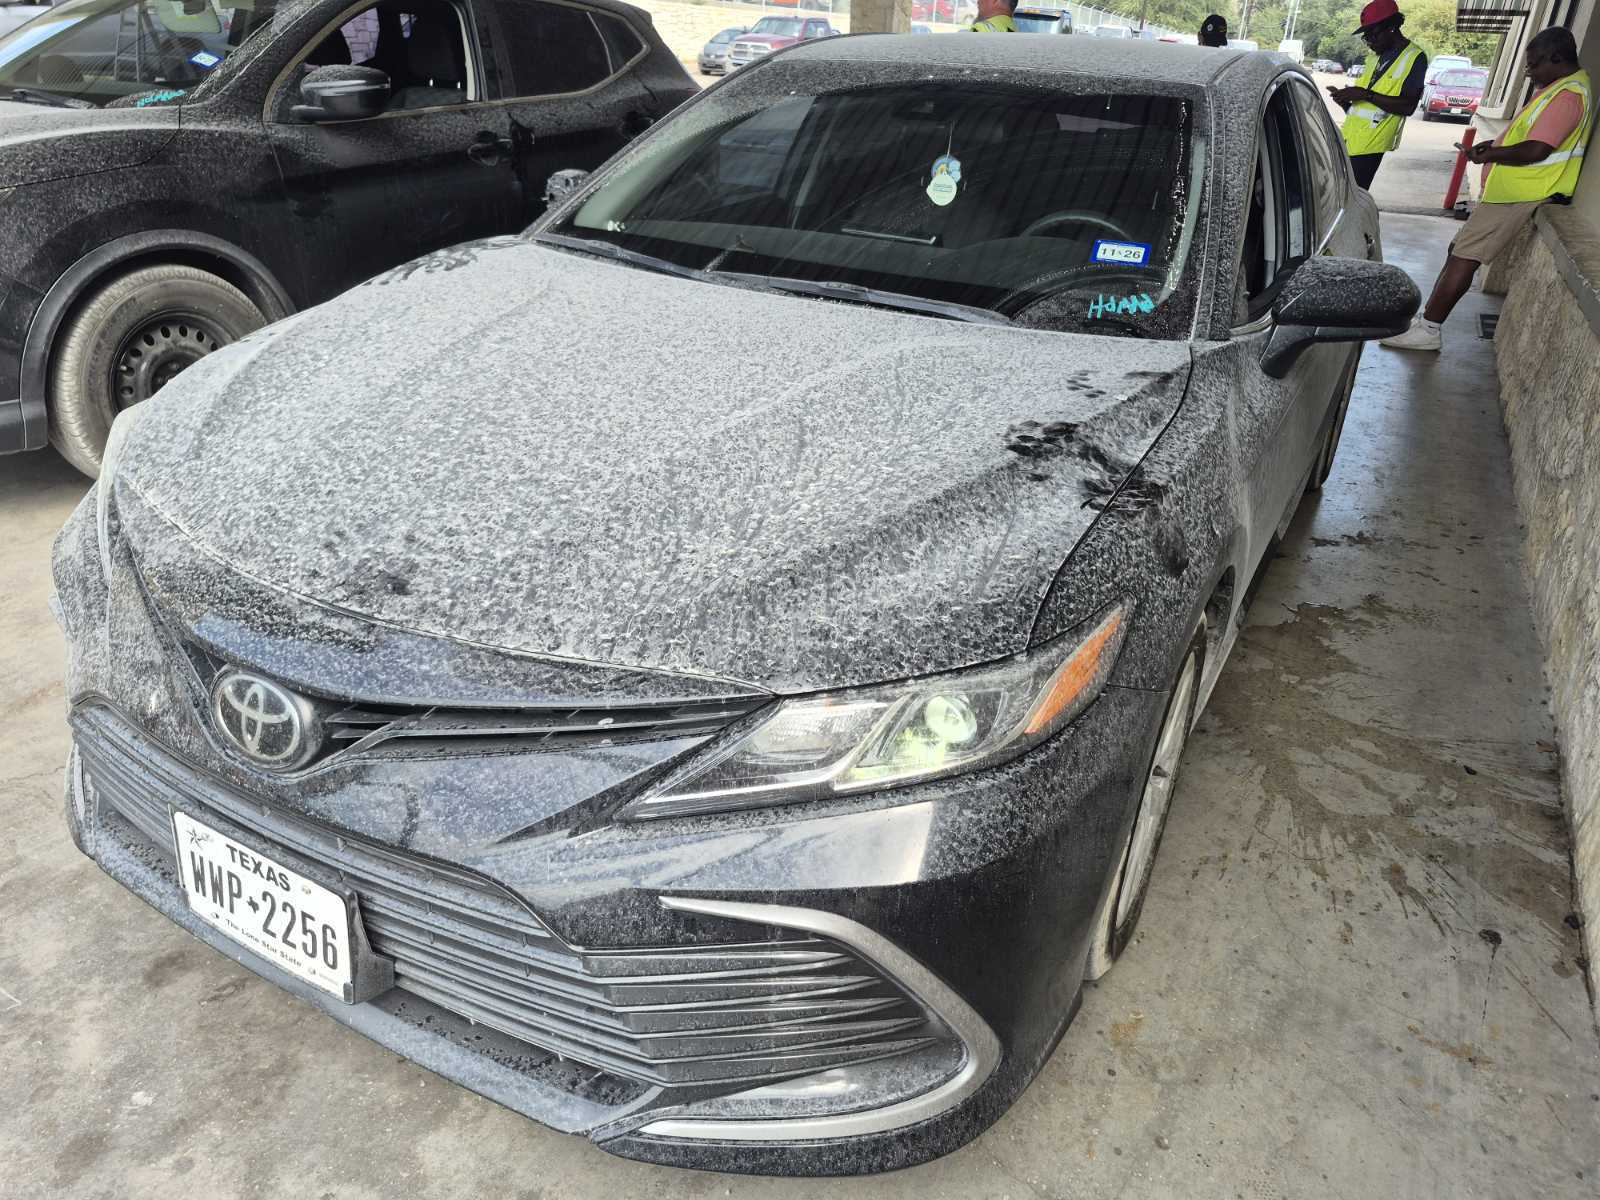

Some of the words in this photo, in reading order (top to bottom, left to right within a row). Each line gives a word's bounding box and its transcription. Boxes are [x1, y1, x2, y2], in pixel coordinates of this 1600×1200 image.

[226, 843, 291, 892] TEXAS
[190, 851, 243, 914] WWP
[262, 890, 338, 970] 2256
[241, 928, 259, 943] Lone
[261, 940, 277, 953] Star
[279, 950, 302, 967] State
